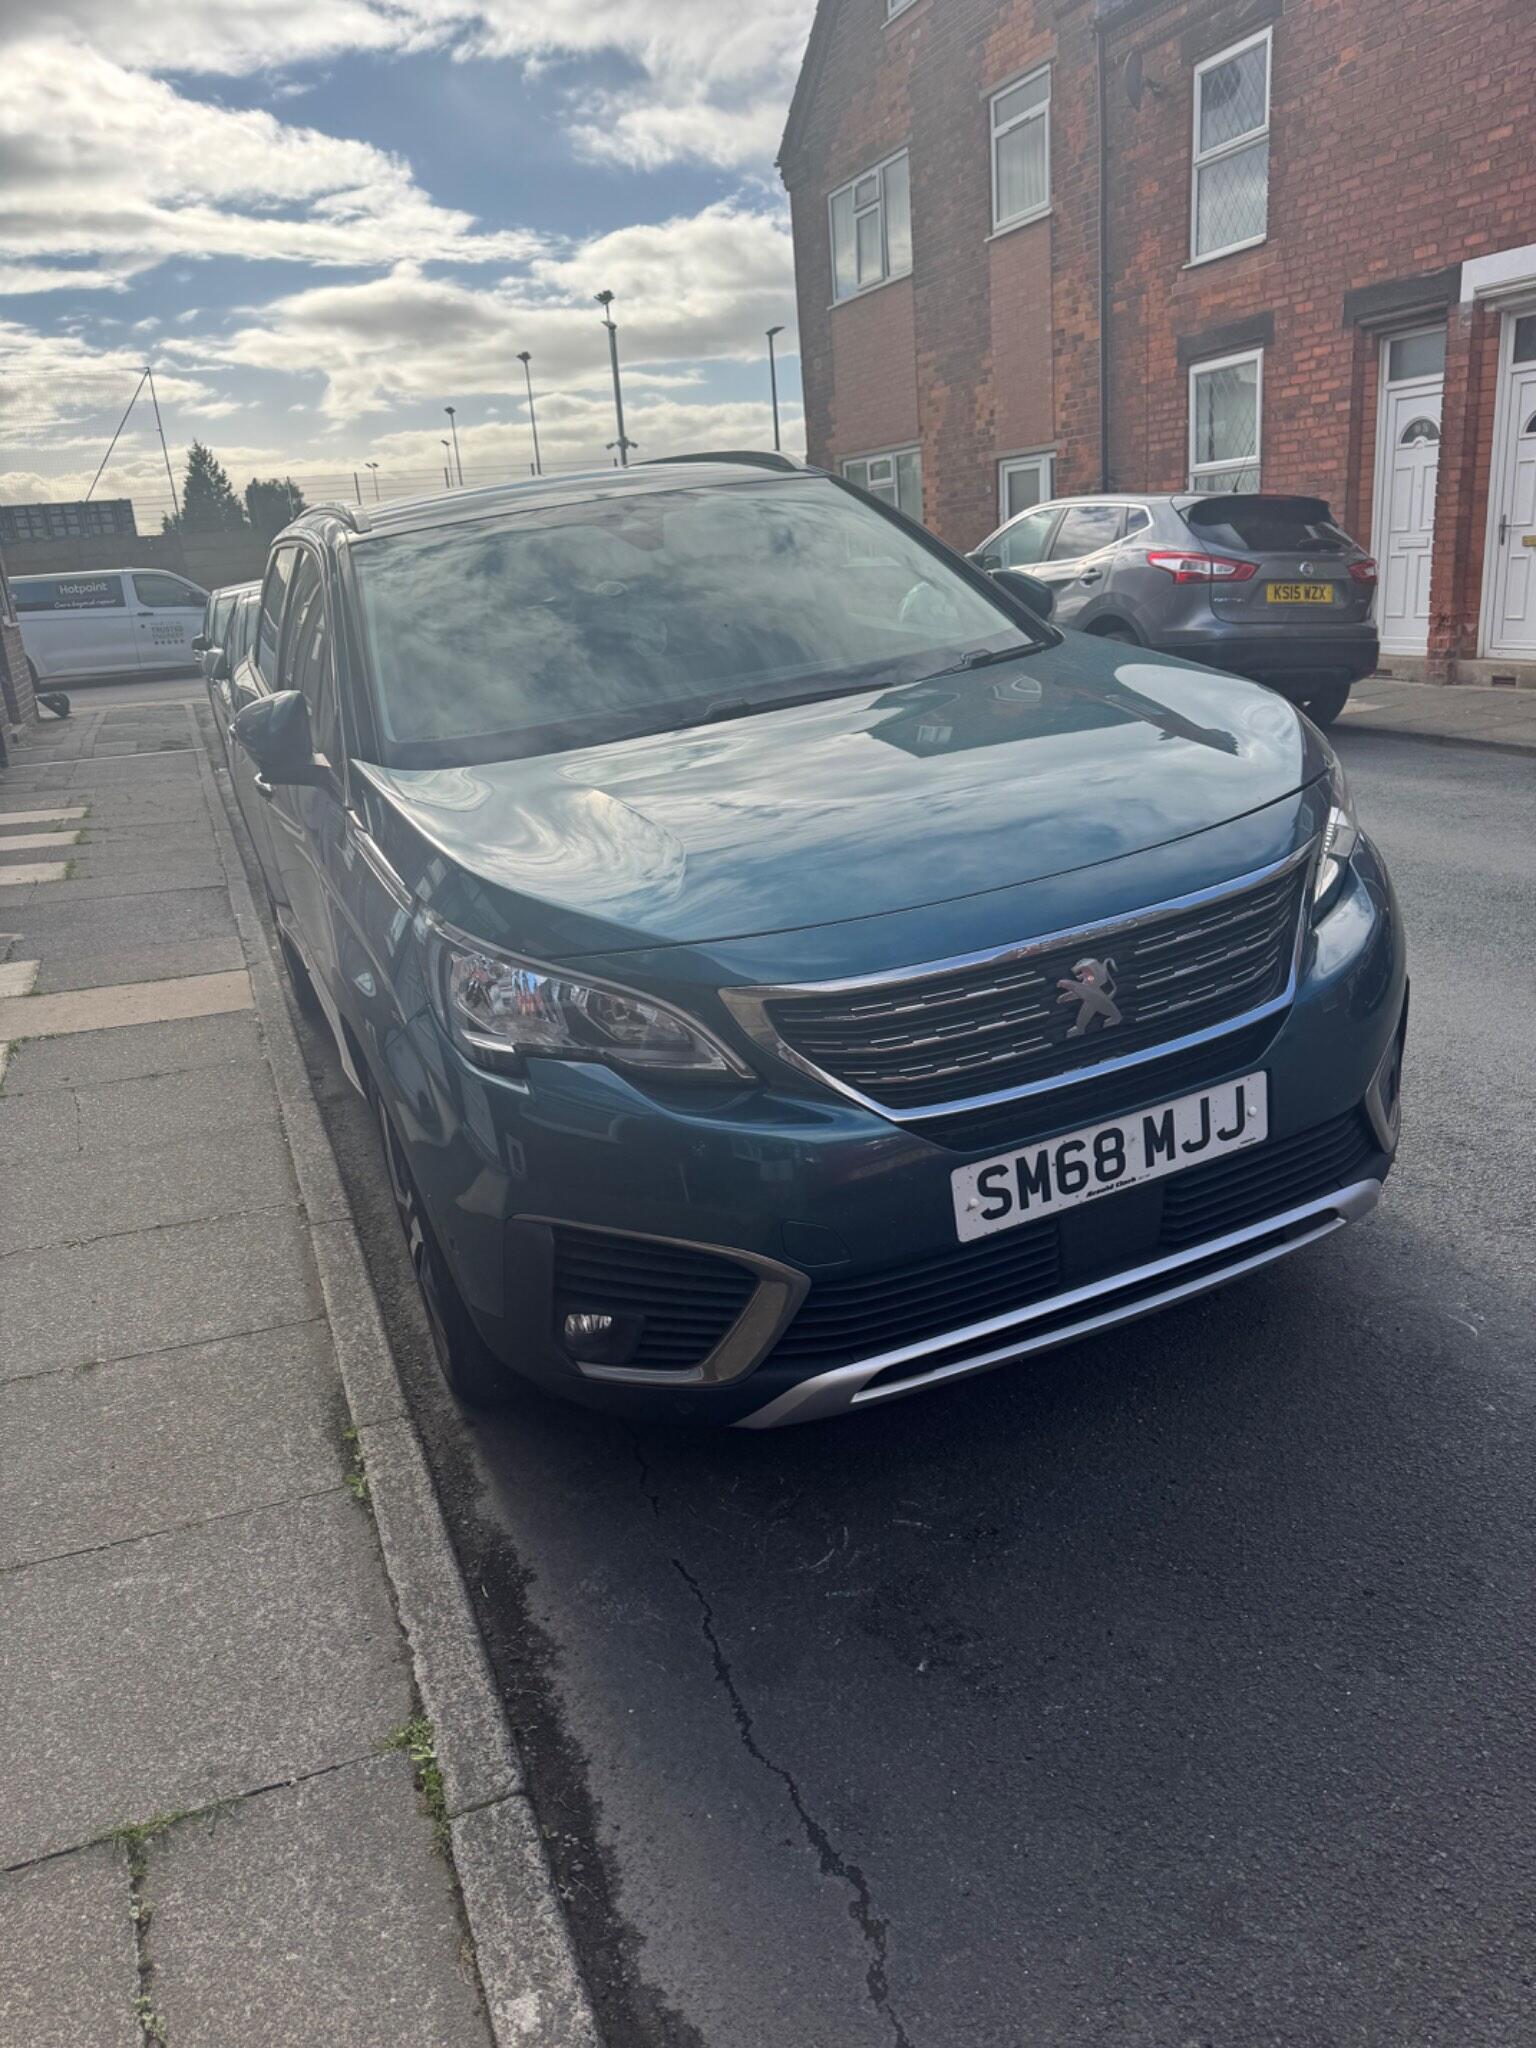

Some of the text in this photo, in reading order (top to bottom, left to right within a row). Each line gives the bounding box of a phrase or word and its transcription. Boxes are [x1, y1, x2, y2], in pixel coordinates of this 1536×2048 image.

[59, 582, 108, 595] Hotpoint
[1274, 585, 1326, 601] KS15 WZX
[977, 1085, 1246, 1221] SM68 MJJ
